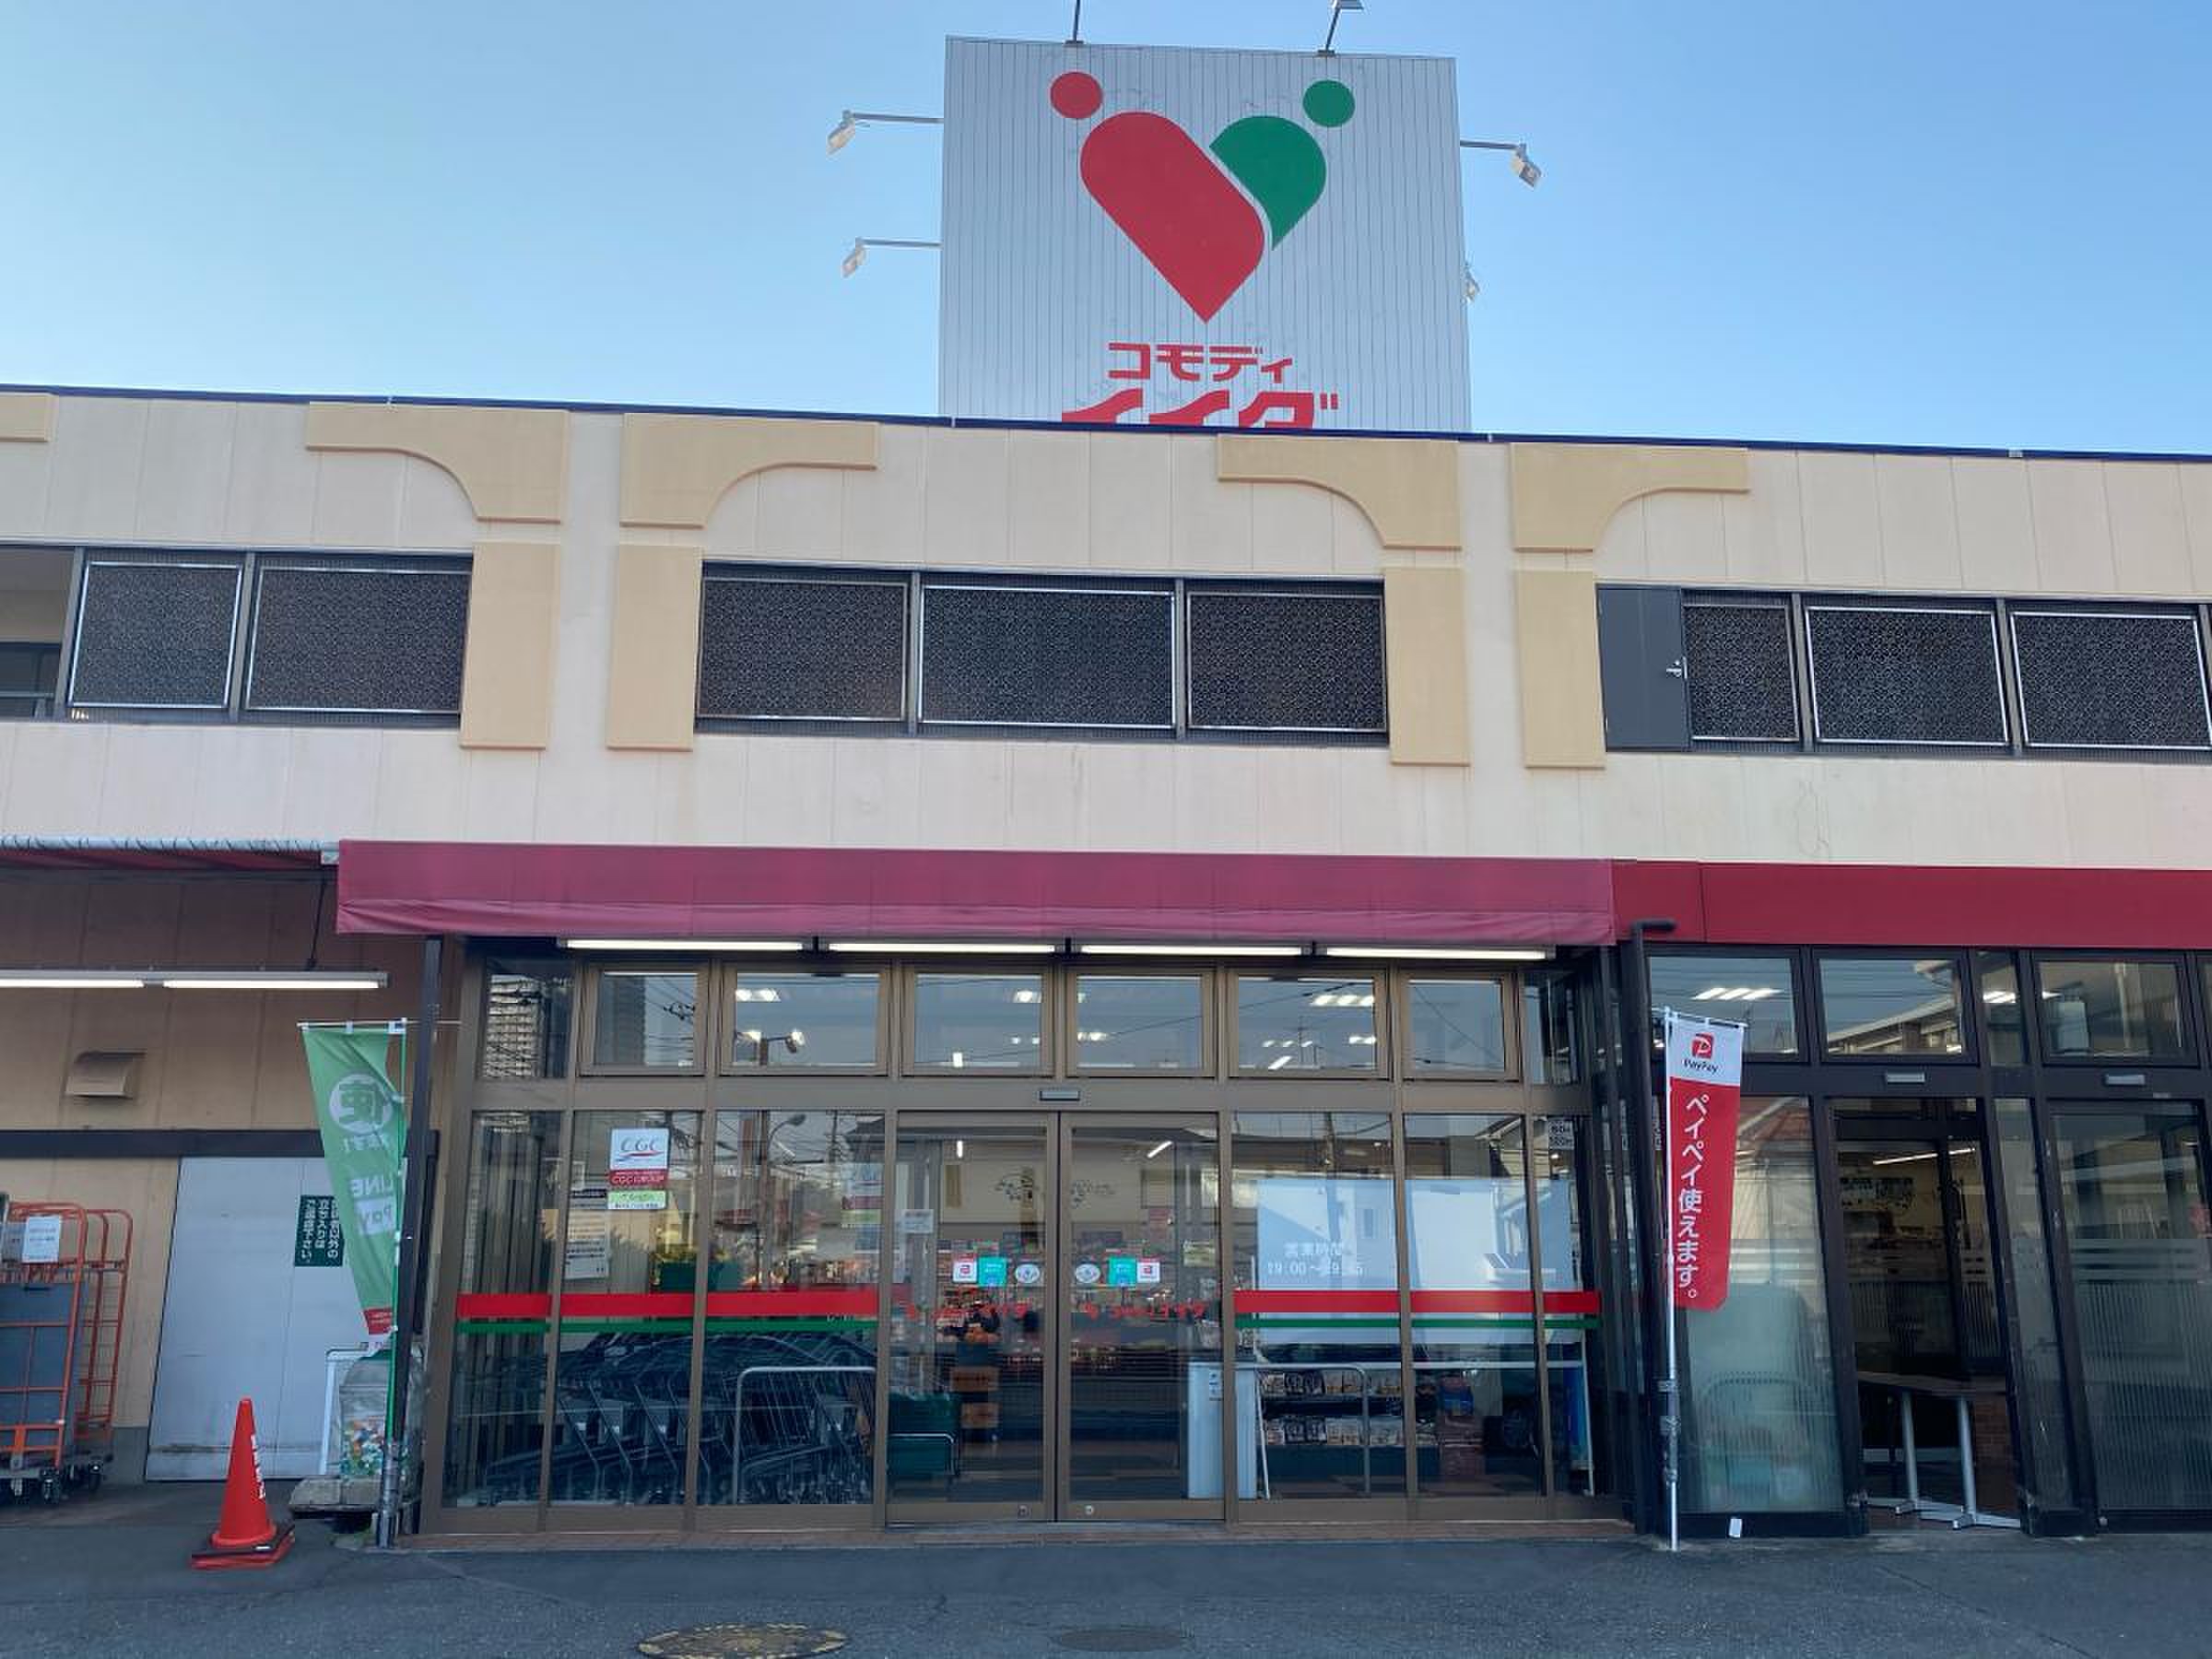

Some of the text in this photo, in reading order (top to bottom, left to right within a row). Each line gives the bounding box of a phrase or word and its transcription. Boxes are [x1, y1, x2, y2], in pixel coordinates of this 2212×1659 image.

[1108, 342, 1293, 383] コモディ
[1684, 1059, 1719, 1075] PayPay
[620, 1135, 661, 1152] CGC
[1675, 1093, 1711, 1299] ペイペイ使えます。
